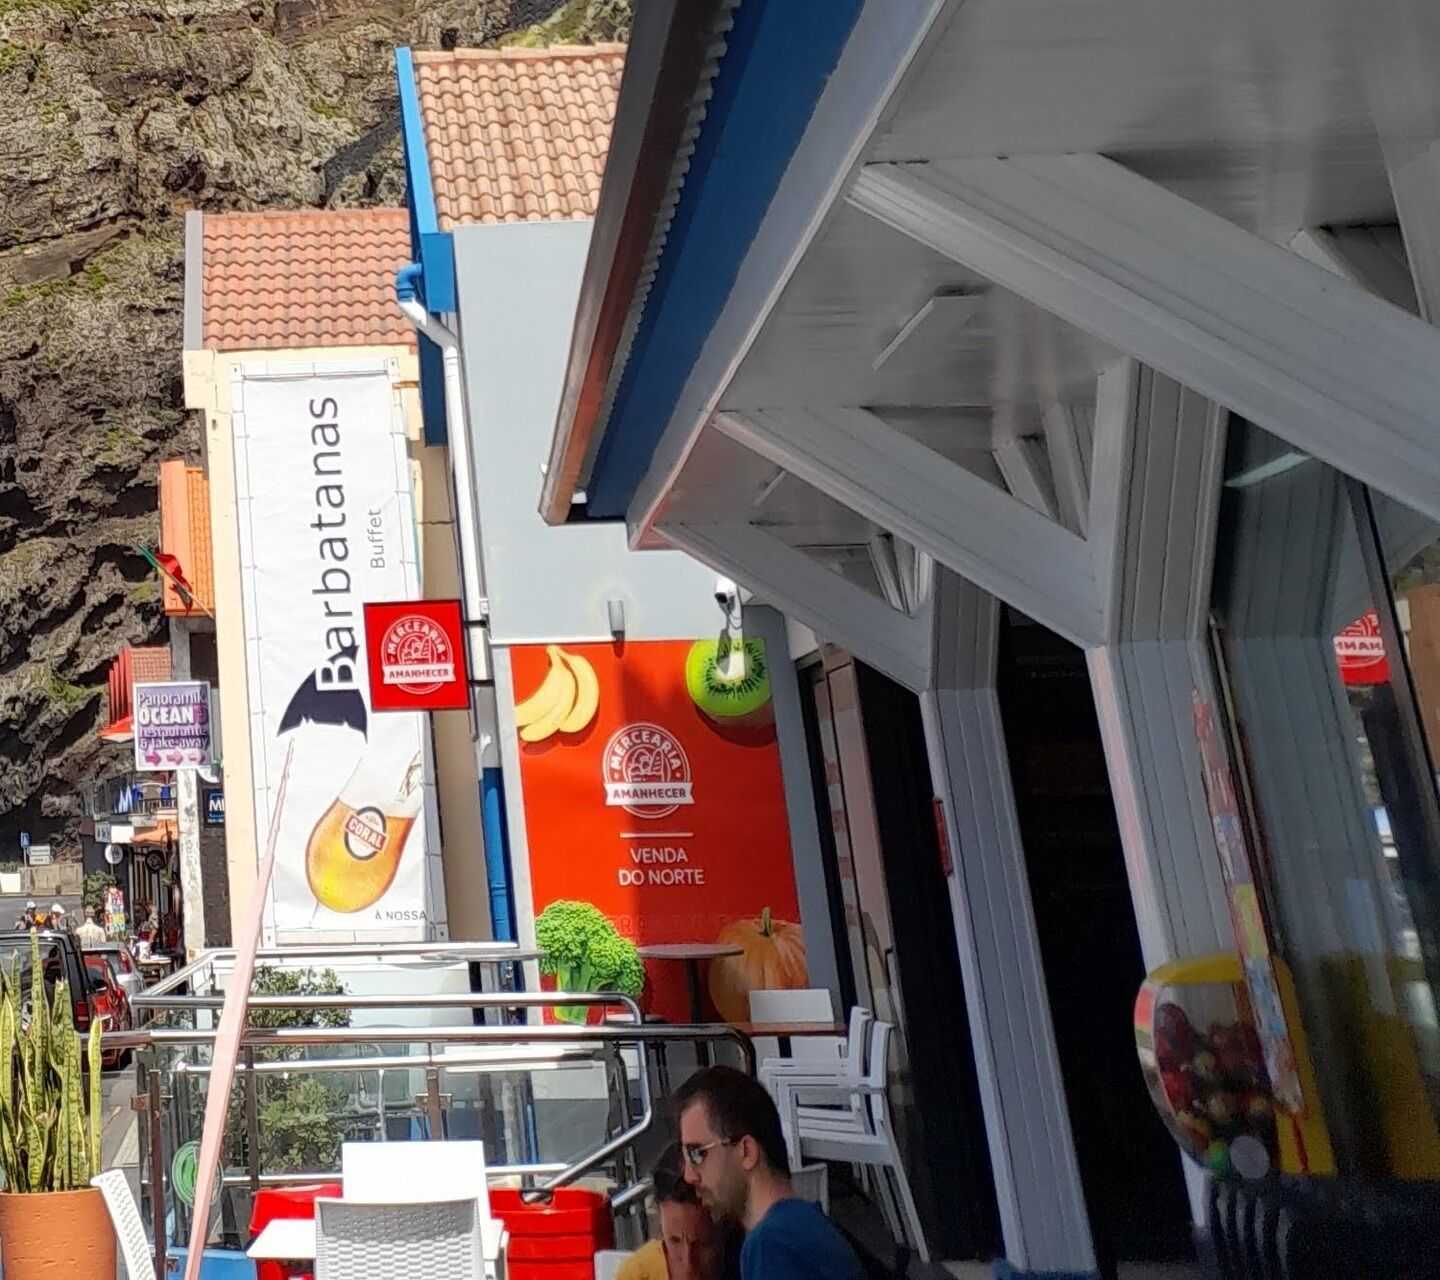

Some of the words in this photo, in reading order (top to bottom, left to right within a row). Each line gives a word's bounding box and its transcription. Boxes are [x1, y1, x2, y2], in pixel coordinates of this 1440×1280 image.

[309, 396, 358, 690] Barbatanas
[366, 508, 386, 569] Buffet
[387, 621, 446, 655] MERCEARIA
[388, 668, 450, 679] AMANHECER
[610, 730, 682, 771] MERCEARIA
[613, 788, 687, 800] AMANHECER
[348, 817, 383, 848] CORAL
[630, 847, 688, 864] VENDA
[618, 869, 645, 886] DO
[648, 869, 705, 886] NORTE
[386, 910, 427, 921] NOSSA
